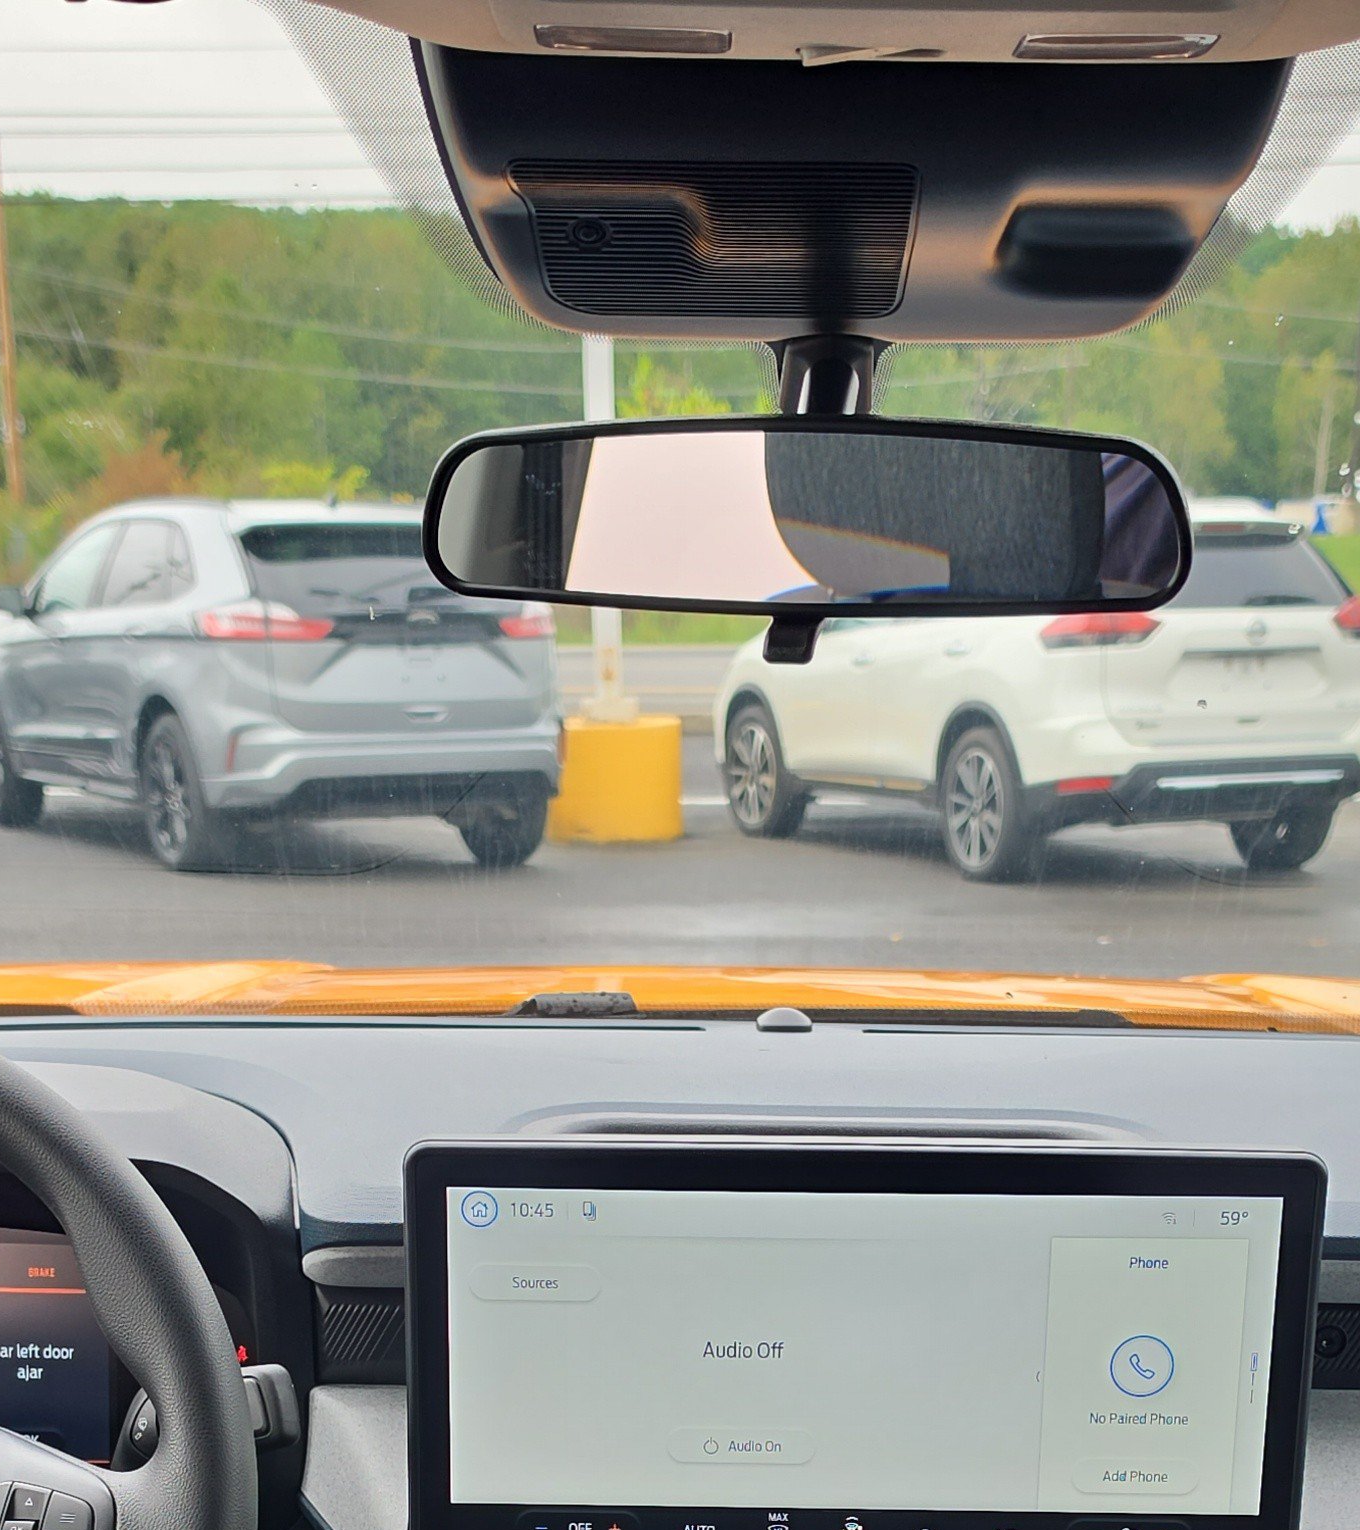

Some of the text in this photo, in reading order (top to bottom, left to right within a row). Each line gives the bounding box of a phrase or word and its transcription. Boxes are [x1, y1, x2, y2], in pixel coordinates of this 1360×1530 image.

[509, 1202, 554, 1219] 10:45
[1220, 1210, 1250, 1227] 59°
[1129, 1255, 1169, 1271] Phone
[512, 1275, 559, 1291] Sources
[16, 1343, 38, 1359] left
[42, 1343, 74, 1359] door
[702, 1340, 784, 1360] Audio Off
[16, 1366, 43, 1381] ajar
[1089, 1412, 1189, 1427] No Paired Phone
[728, 1439, 782, 1455] Audio On
[1103, 1469, 1168, 1484] Add Phone
[768, 1512, 788, 1523] MAX
